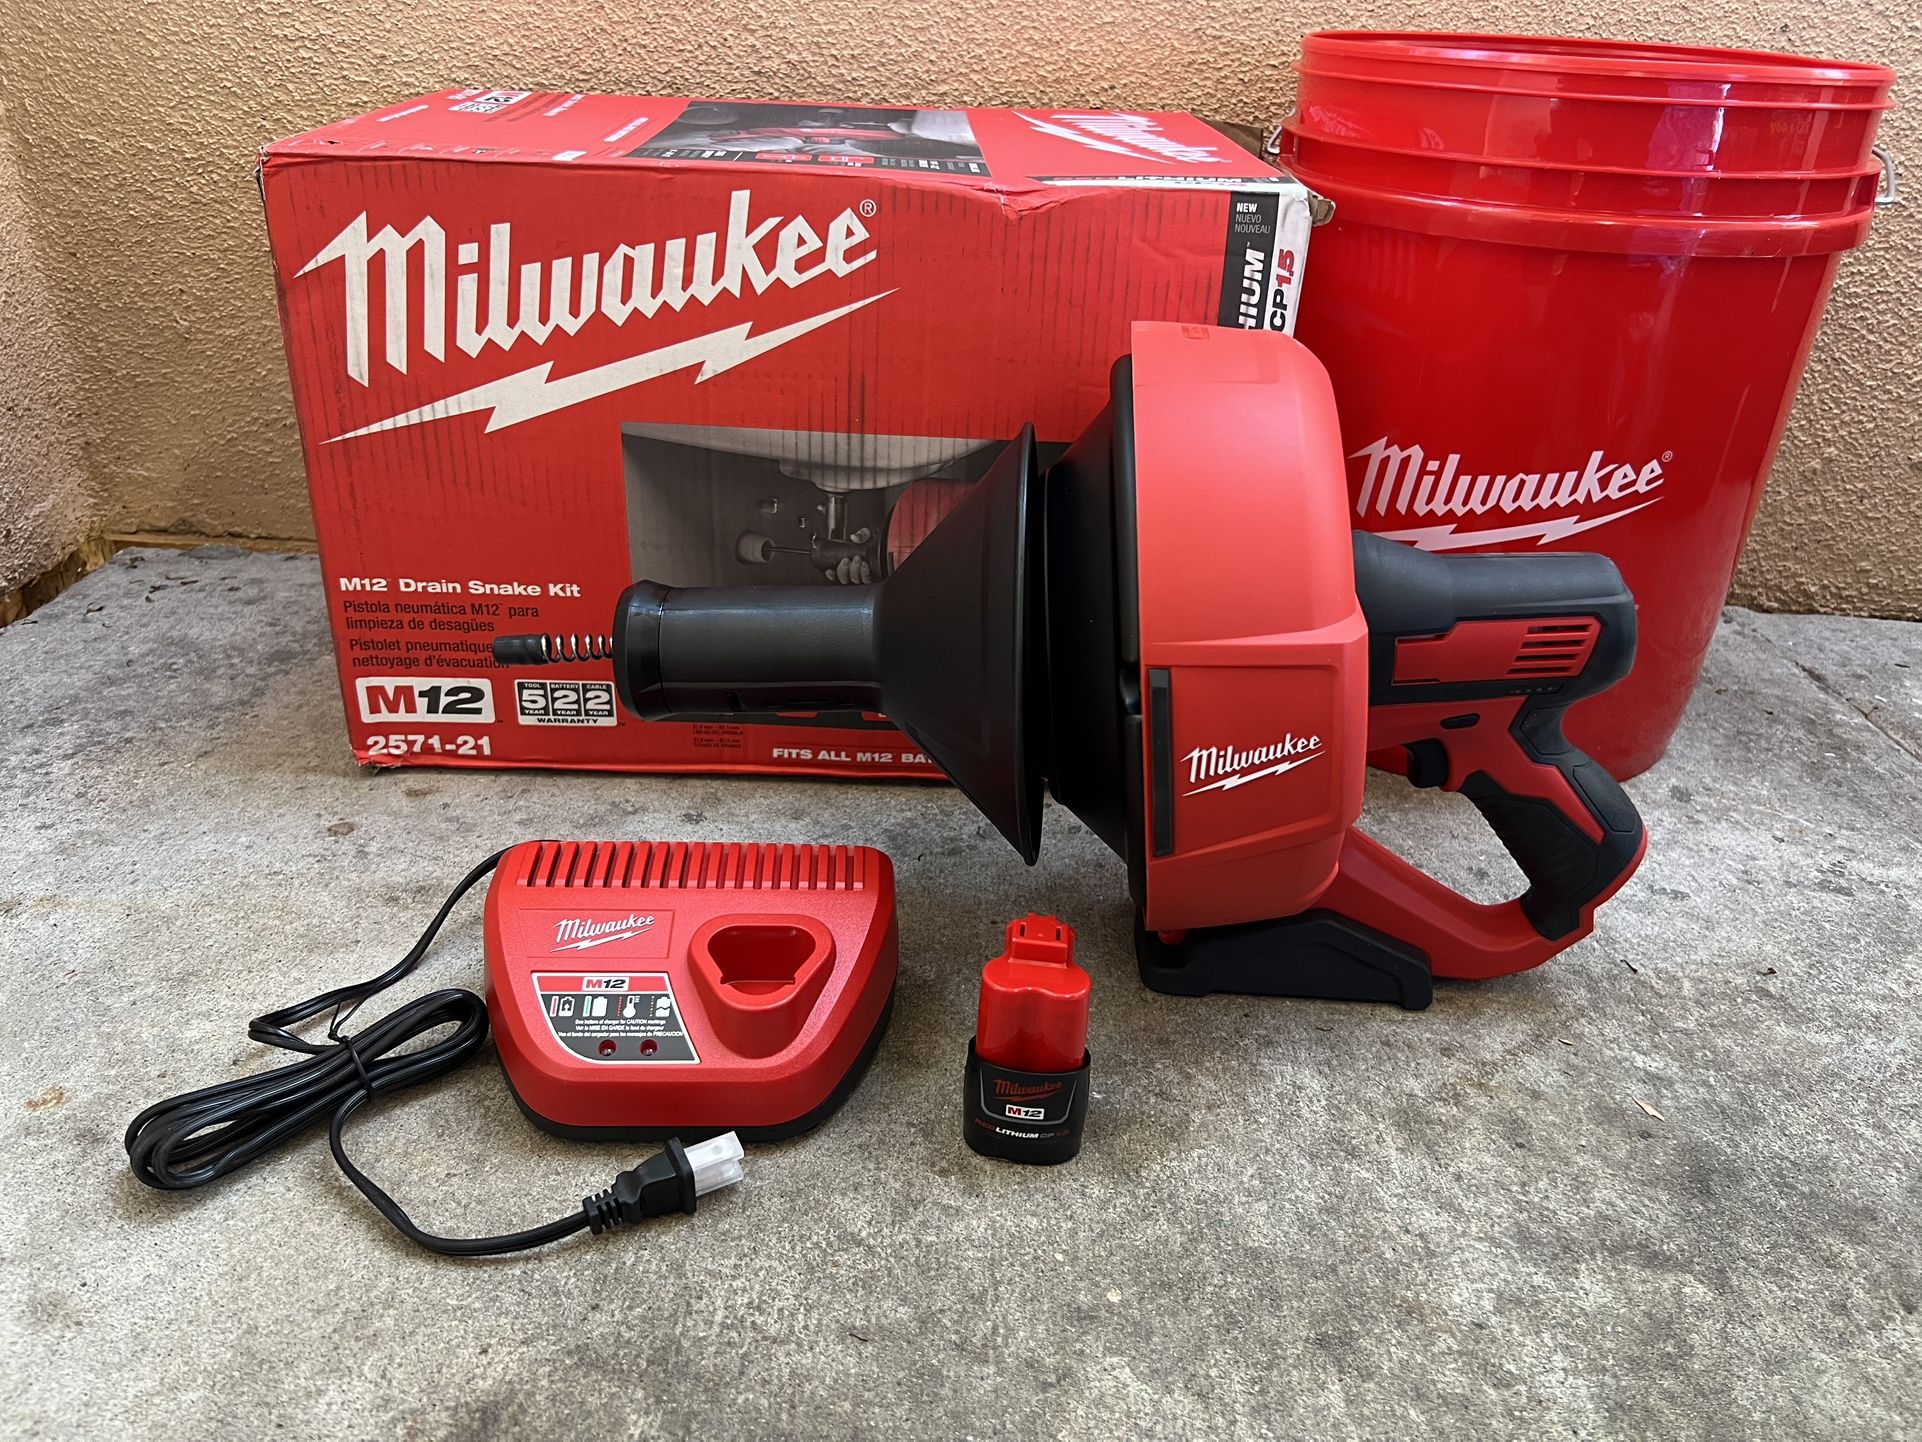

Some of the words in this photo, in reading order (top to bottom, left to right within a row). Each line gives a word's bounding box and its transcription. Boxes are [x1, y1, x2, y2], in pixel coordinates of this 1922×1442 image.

[1236, 203, 1258, 212] NEW
[1235, 214, 1261, 223] NUEVO
[1234, 224, 1271, 233] NOUVEAU
[291, 189, 877, 388] Milwaukee
[1348, 436, 1664, 518] Milwaukee
[399, 578, 461, 593] Drain
[468, 580, 541, 596] Snake
[548, 583, 581, 598] Kit
[343, 600, 391, 614] Pistola
[394, 601, 467, 616] neumática
[508, 607, 540, 619] para
[345, 617, 403, 631] limpieza
[408, 618, 425, 630] de
[429, 618, 495, 634] desagües
[349, 638, 400, 651] Pistolet
[405, 640, 493, 654] pneumatique
[352, 654, 420, 669] nettoyage
[365, 685, 485, 715] M12
[521, 689, 547, 710] 5
[553, 690, 579, 710] 2
[585, 690, 611, 711] 2
[536, 717, 599, 725] WARRANTY
[366, 735, 491, 756] 2571-21
[772, 748, 813, 759] FITS
[817, 750, 851, 761] ALL
[856, 752, 893, 762] M12
[901, 753, 932, 763] BA
[1179, 733, 1322, 783] Milwaukee
[553, 914, 655, 943] Milwaukee
[585, 979, 626, 989] M12
[992, 1079, 1063, 1095] Milwaukee
[1007, 1106, 1043, 1117] M12
